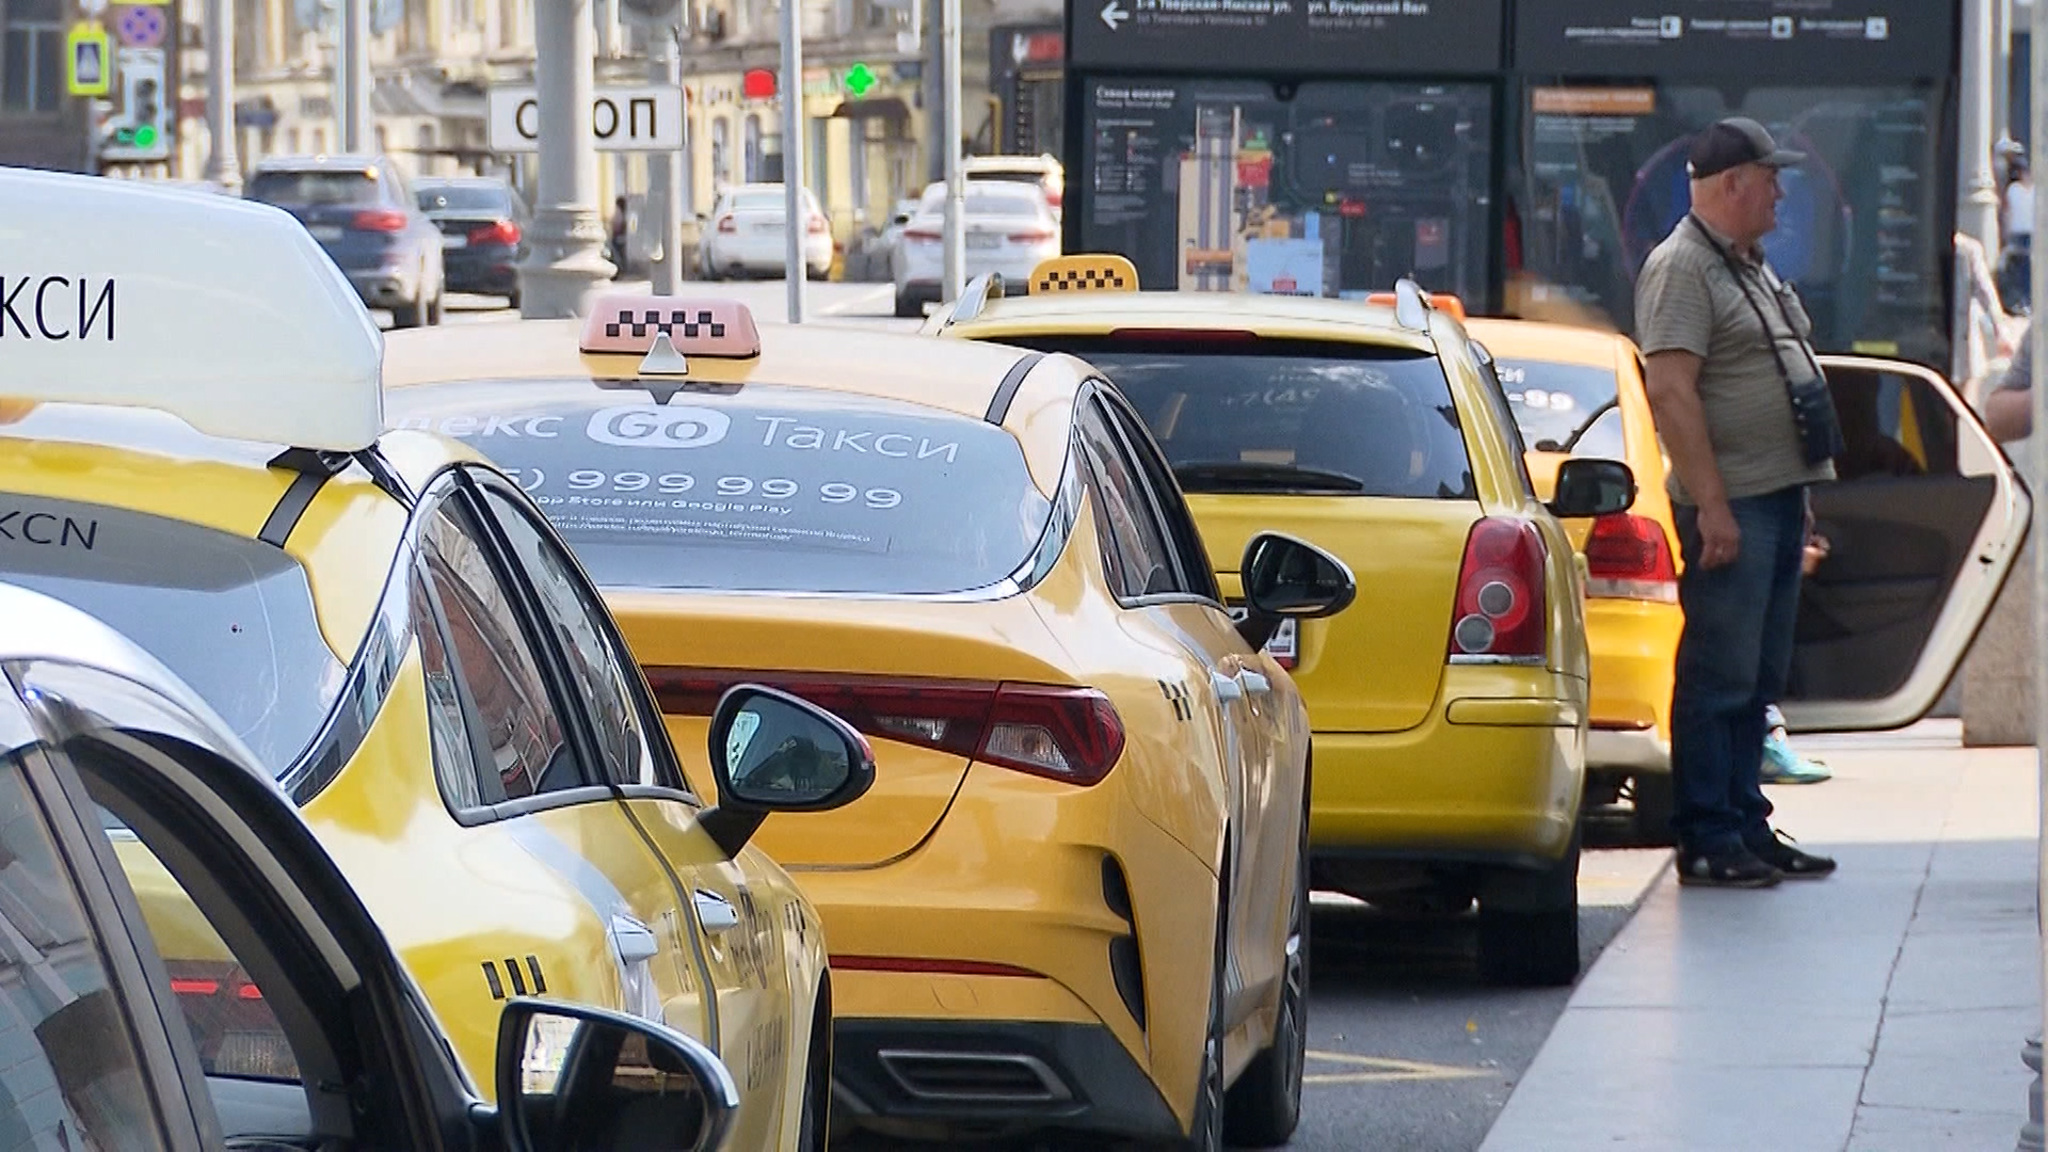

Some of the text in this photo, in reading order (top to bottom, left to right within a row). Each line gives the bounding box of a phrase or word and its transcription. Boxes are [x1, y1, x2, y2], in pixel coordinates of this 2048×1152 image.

[516, 98, 657, 140] СОП
[608, 411, 708, 441] Go
[756, 416, 959, 463] Такси
[568, 470, 694, 493] 999
[717, 477, 798, 498] 99
[820, 483, 902, 508] 99
